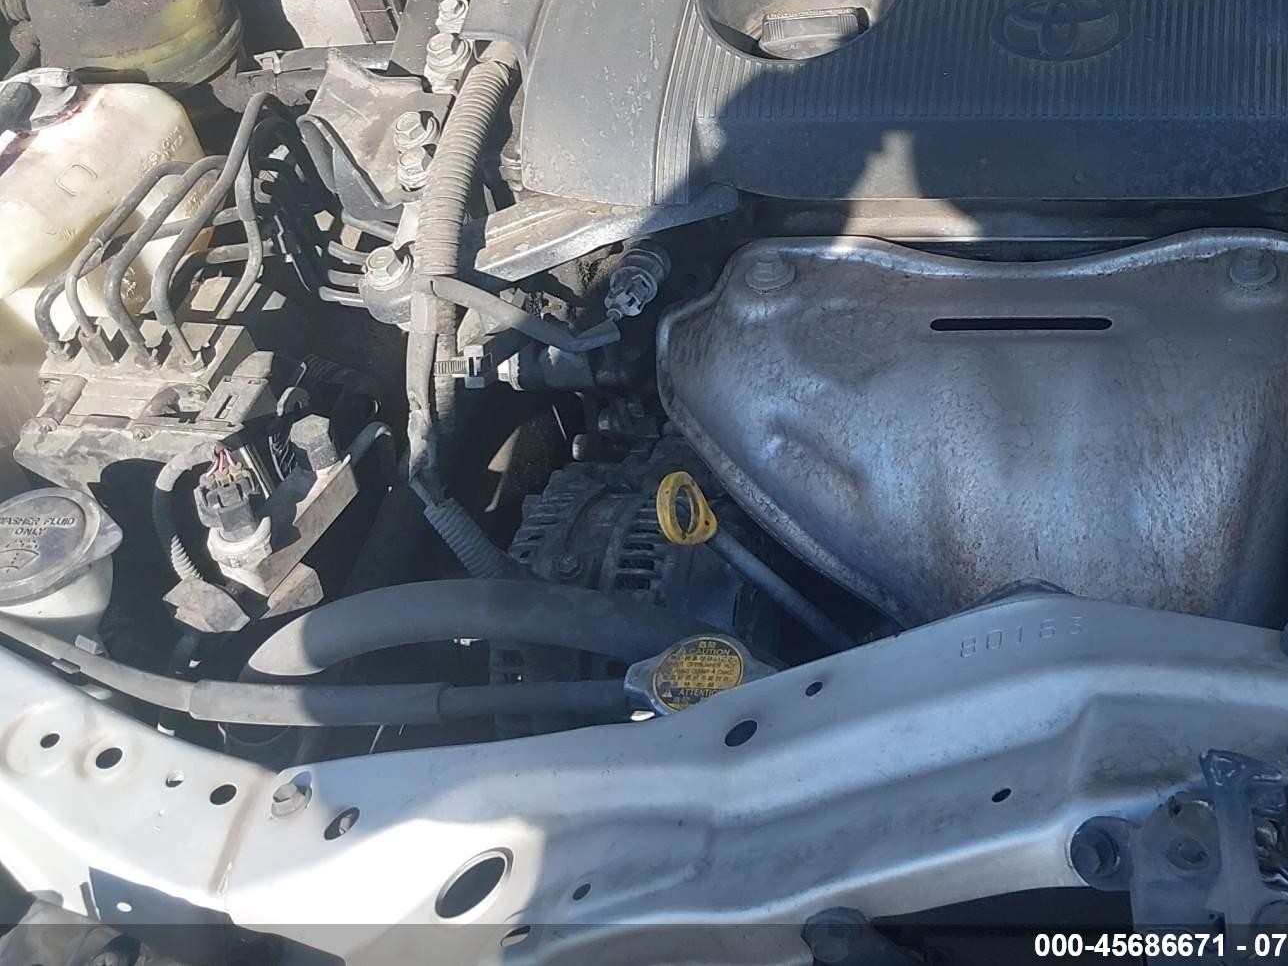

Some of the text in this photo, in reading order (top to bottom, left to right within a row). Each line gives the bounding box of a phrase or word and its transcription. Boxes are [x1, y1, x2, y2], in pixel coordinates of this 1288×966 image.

[14, 527, 47, 536] ONLY
[688, 648, 731, 656] CAUTION
[678, 689, 722, 697] ATTENTIO
